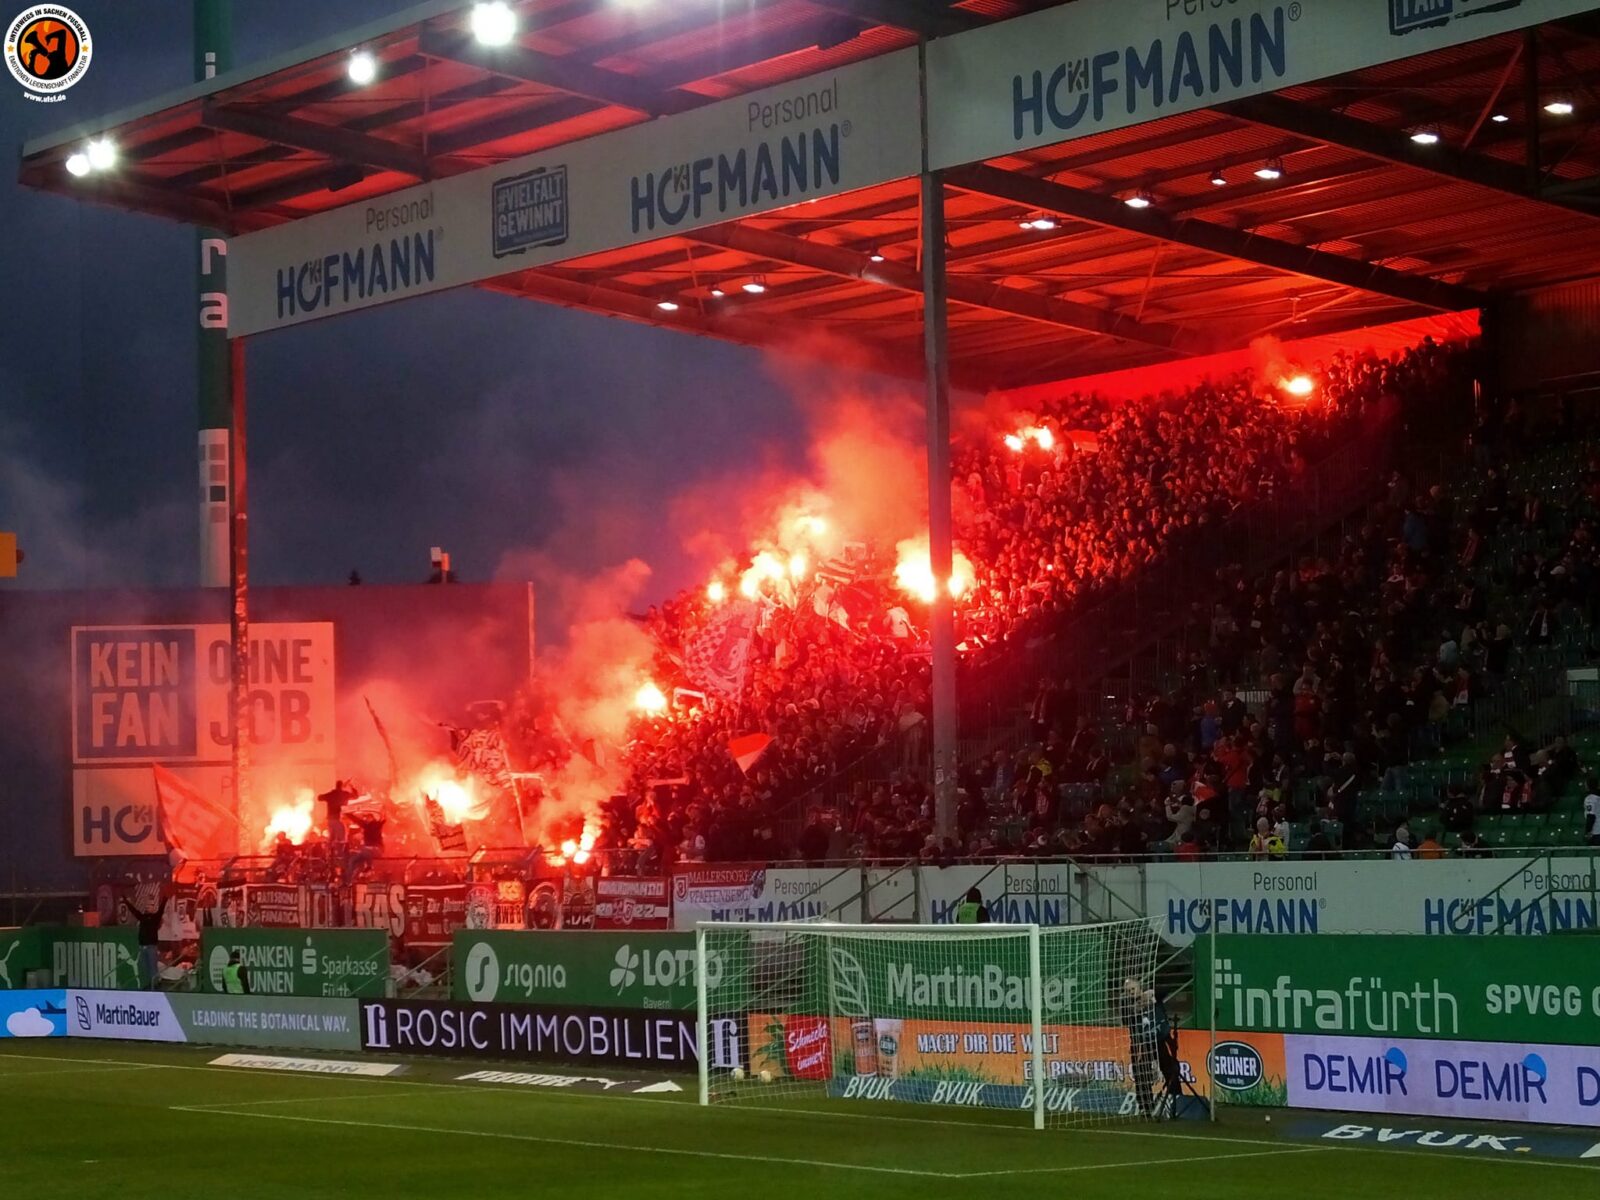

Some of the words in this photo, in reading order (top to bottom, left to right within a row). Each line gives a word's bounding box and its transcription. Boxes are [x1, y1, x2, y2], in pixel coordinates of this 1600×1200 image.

[1012, 6, 1286, 140] HOFMANN
[748, 77, 839, 133] Personal
[631, 122, 840, 235] HOFMANN
[366, 190, 435, 234] Personal
[498, 199, 562, 238] GEWINNT
[277, 228, 434, 319] HOFMANN
[90, 641, 180, 688] KEIN
[92, 692, 180, 747] FAN
[688, 869, 750, 883] MALLERSDORF
[774, 877, 822, 896] Personal
[1005, 873, 1060, 892] Personal
[1253, 871, 1318, 892] Personal
[688, 887, 751, 904] PFAFFENBERG
[1168, 897, 1319, 935] HOFMANN
[53, 942, 117, 988] PUMA
[321, 954, 379, 978] Sparkasse
[503, 961, 566, 997] signia
[643, 949, 723, 988] LOTTO
[96, 1003, 160, 1028] MartinBauer
[1485, 984, 1582, 1017] SPVGG
[191, 1010, 236, 1029] LEADING
[238, 1012, 258, 1029] THE
[260, 1012, 320, 1032] BOTANICAL
[321, 1016, 350, 1033] WAY.
[396, 1008, 489, 1049] ROSIC
[500, 1012, 699, 1061] IMMOBILIEN
[963, 1034, 990, 1053] DIR
[992, 1034, 1017, 1054] DIE
[1021, 1033, 1060, 1054] WLT
[1051, 1060, 1125, 1082] BISSCHEN
[1304, 1051, 1408, 1096] DEMIR
[1435, 1058, 1548, 1104] DEMIR
